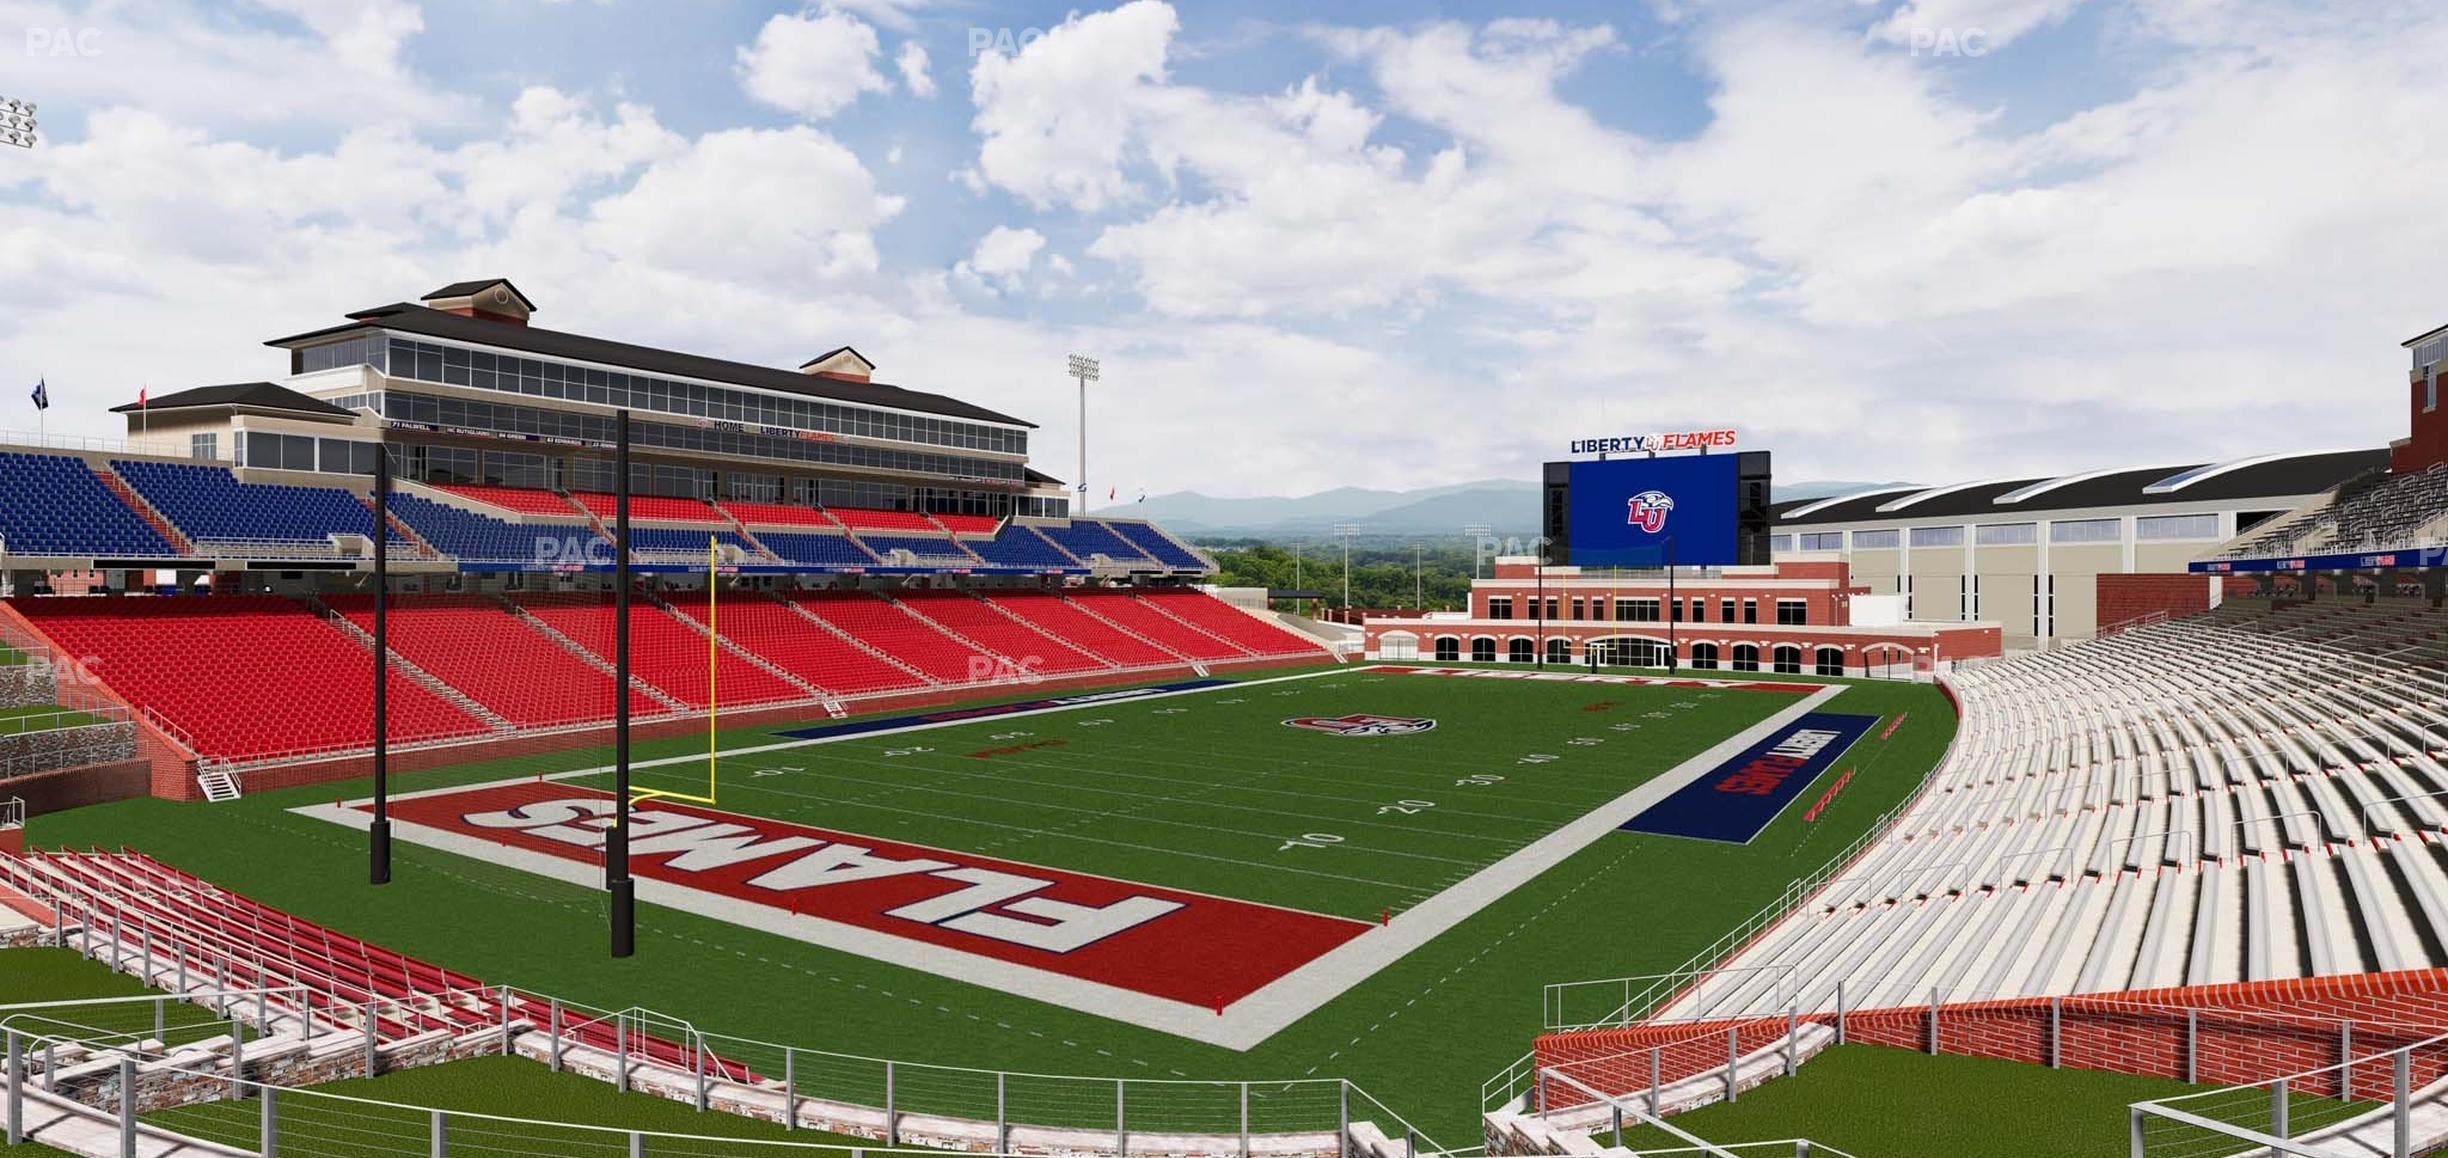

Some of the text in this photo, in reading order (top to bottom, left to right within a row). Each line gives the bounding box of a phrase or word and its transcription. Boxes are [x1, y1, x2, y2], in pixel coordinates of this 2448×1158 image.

[714, 421, 744, 433] HOME
[760, 426, 800, 440] LIBERTY
[1571, 436, 1645, 454] LIBERTY
[1663, 430, 1736, 449] FLAMES
[751, 767, 806, 778] 10
[1455, 774, 1505, 787] 30
[1377, 800, 1436, 815] 20
[1278, 833, 1345, 850] 10
[458, 797, 1190, 953] FLAMES
